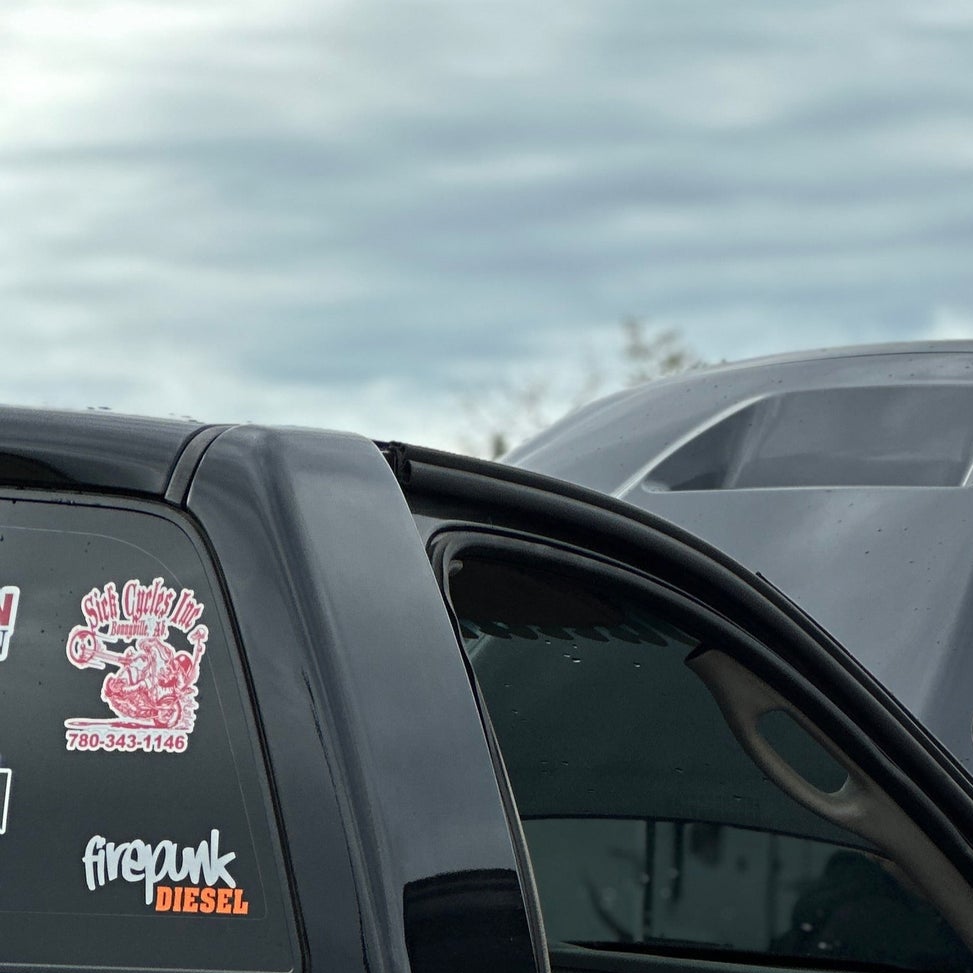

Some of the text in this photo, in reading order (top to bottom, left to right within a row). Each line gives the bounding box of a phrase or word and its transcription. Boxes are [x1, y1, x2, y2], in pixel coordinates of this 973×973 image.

[83, 582, 202, 630] Sick Cycles Inc
[68, 733, 186, 750] 780-343-1146
[82, 829, 237, 905] firepunk
[155, 886, 249, 915] DIESEL
